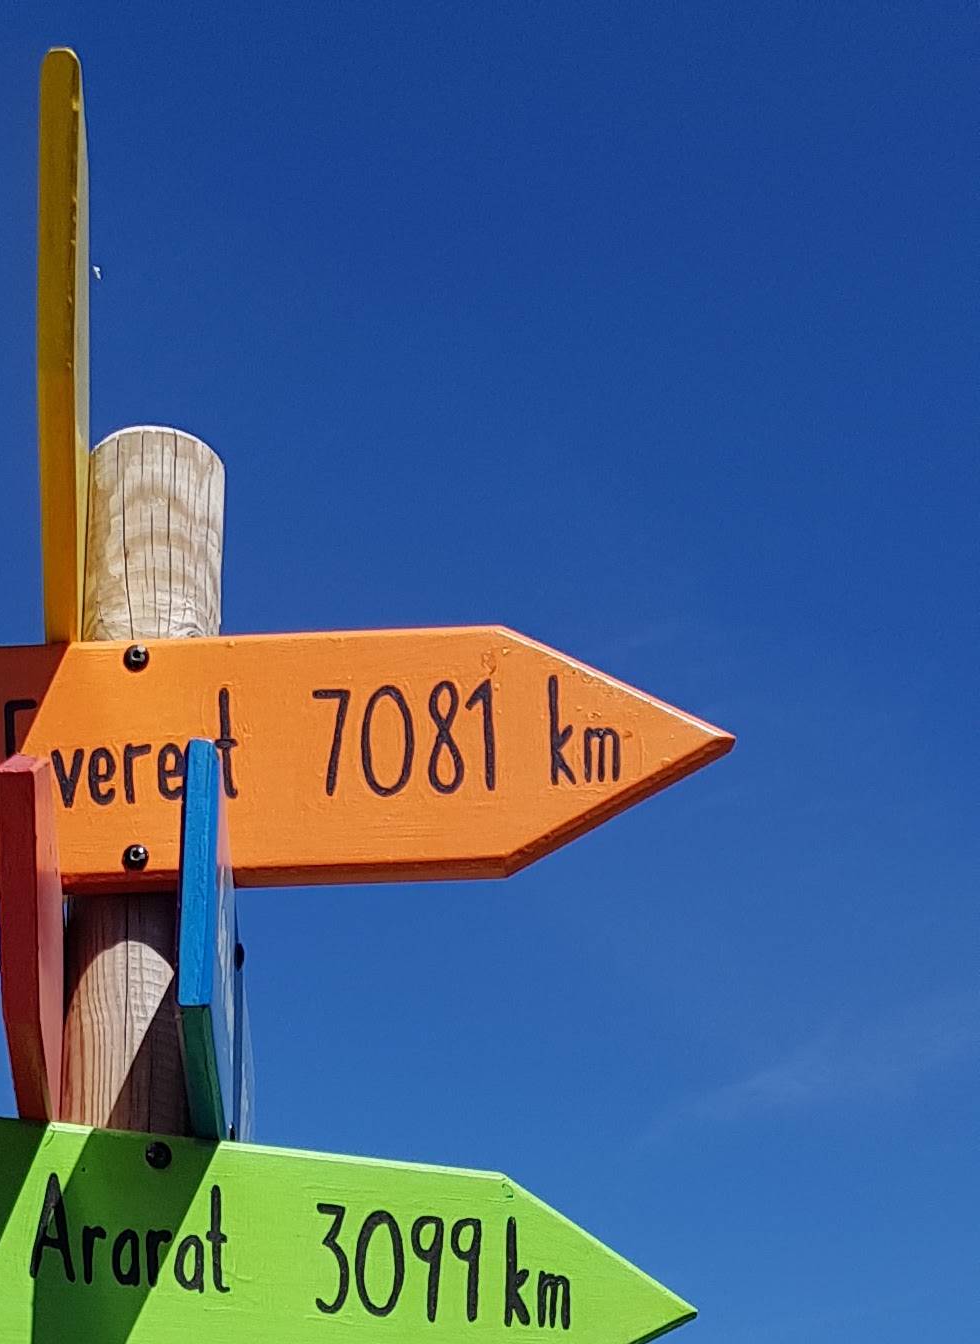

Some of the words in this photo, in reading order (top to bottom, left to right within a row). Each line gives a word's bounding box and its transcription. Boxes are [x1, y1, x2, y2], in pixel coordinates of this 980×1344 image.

[3, 686, 239, 809] veret
[312, 678, 496, 796] 7081
[547, 675, 621, 785] km
[29, 1172, 231, 1294] Ararat
[315, 1202, 483, 1323] 3099
[504, 1215, 572, 1330] km
